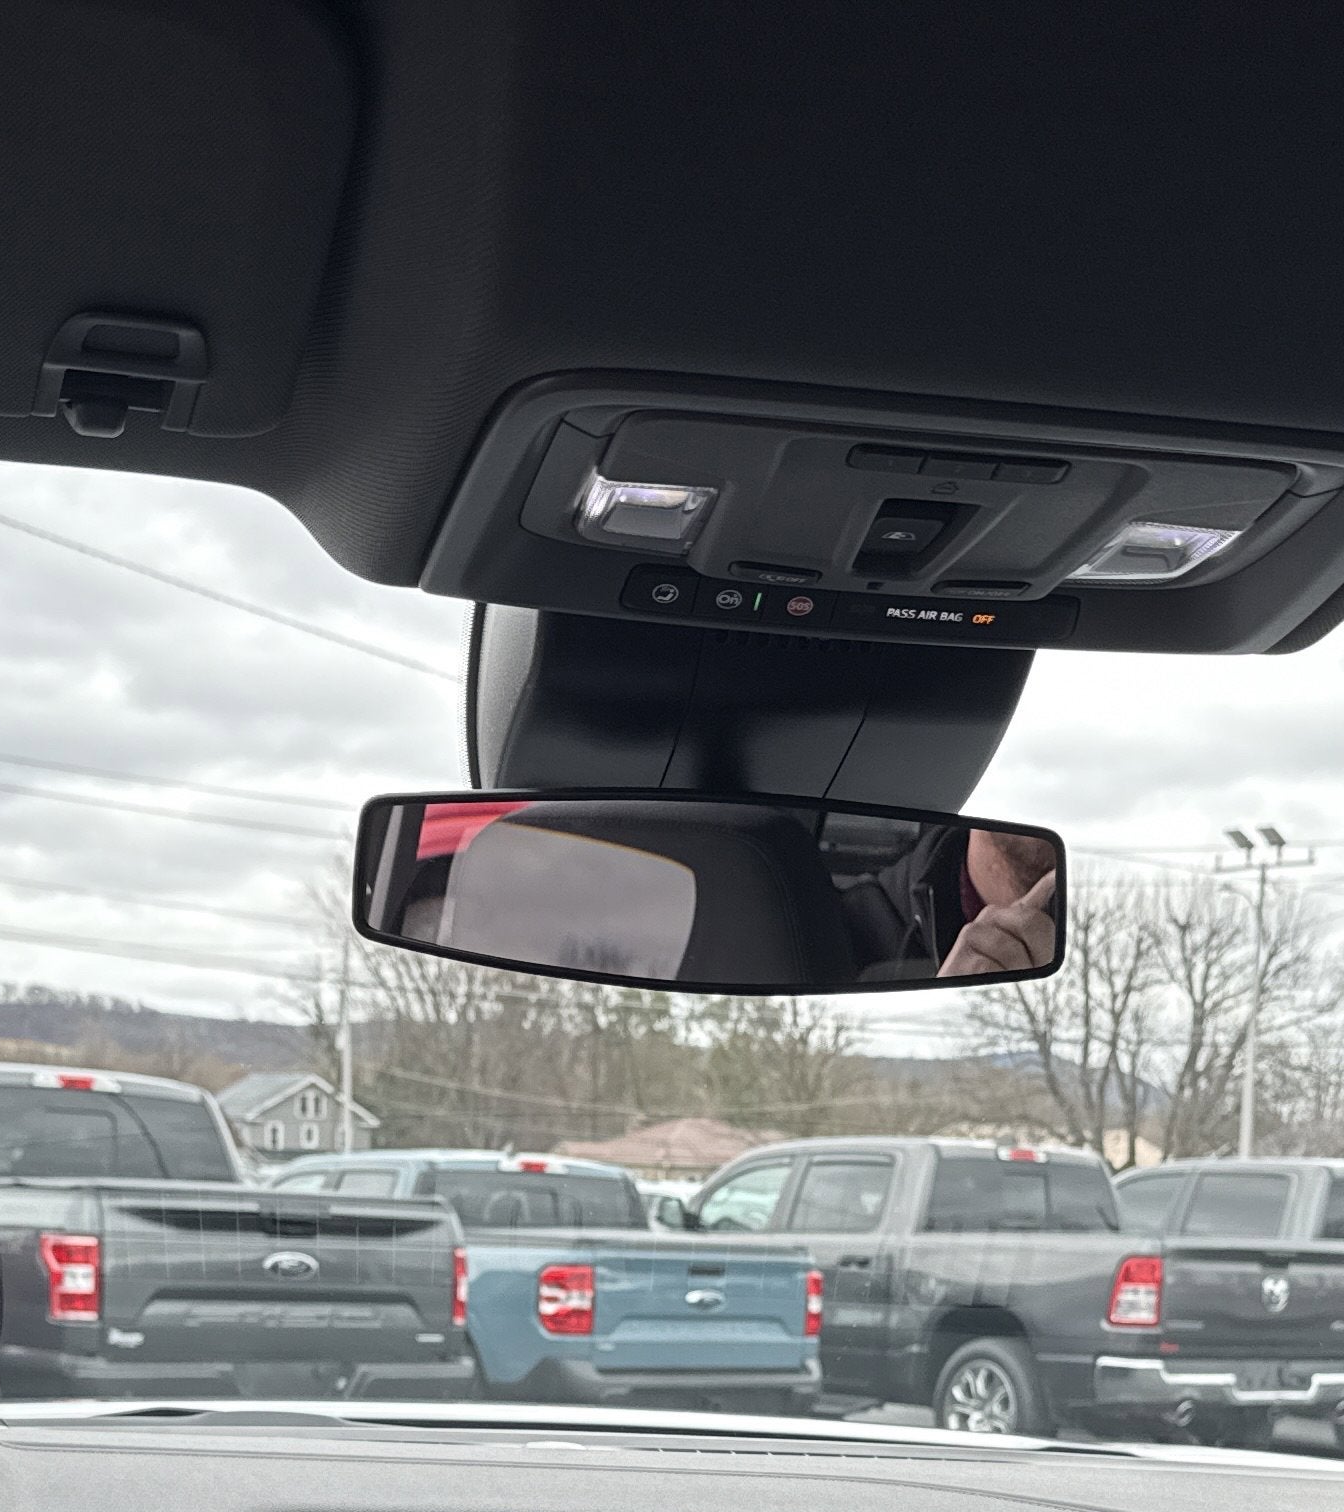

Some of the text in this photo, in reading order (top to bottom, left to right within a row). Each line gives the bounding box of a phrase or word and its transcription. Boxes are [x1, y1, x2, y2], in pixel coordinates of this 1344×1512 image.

[789, 600, 811, 611] SOS
[886, 607, 996, 625] PASS AIR BAG OFF
